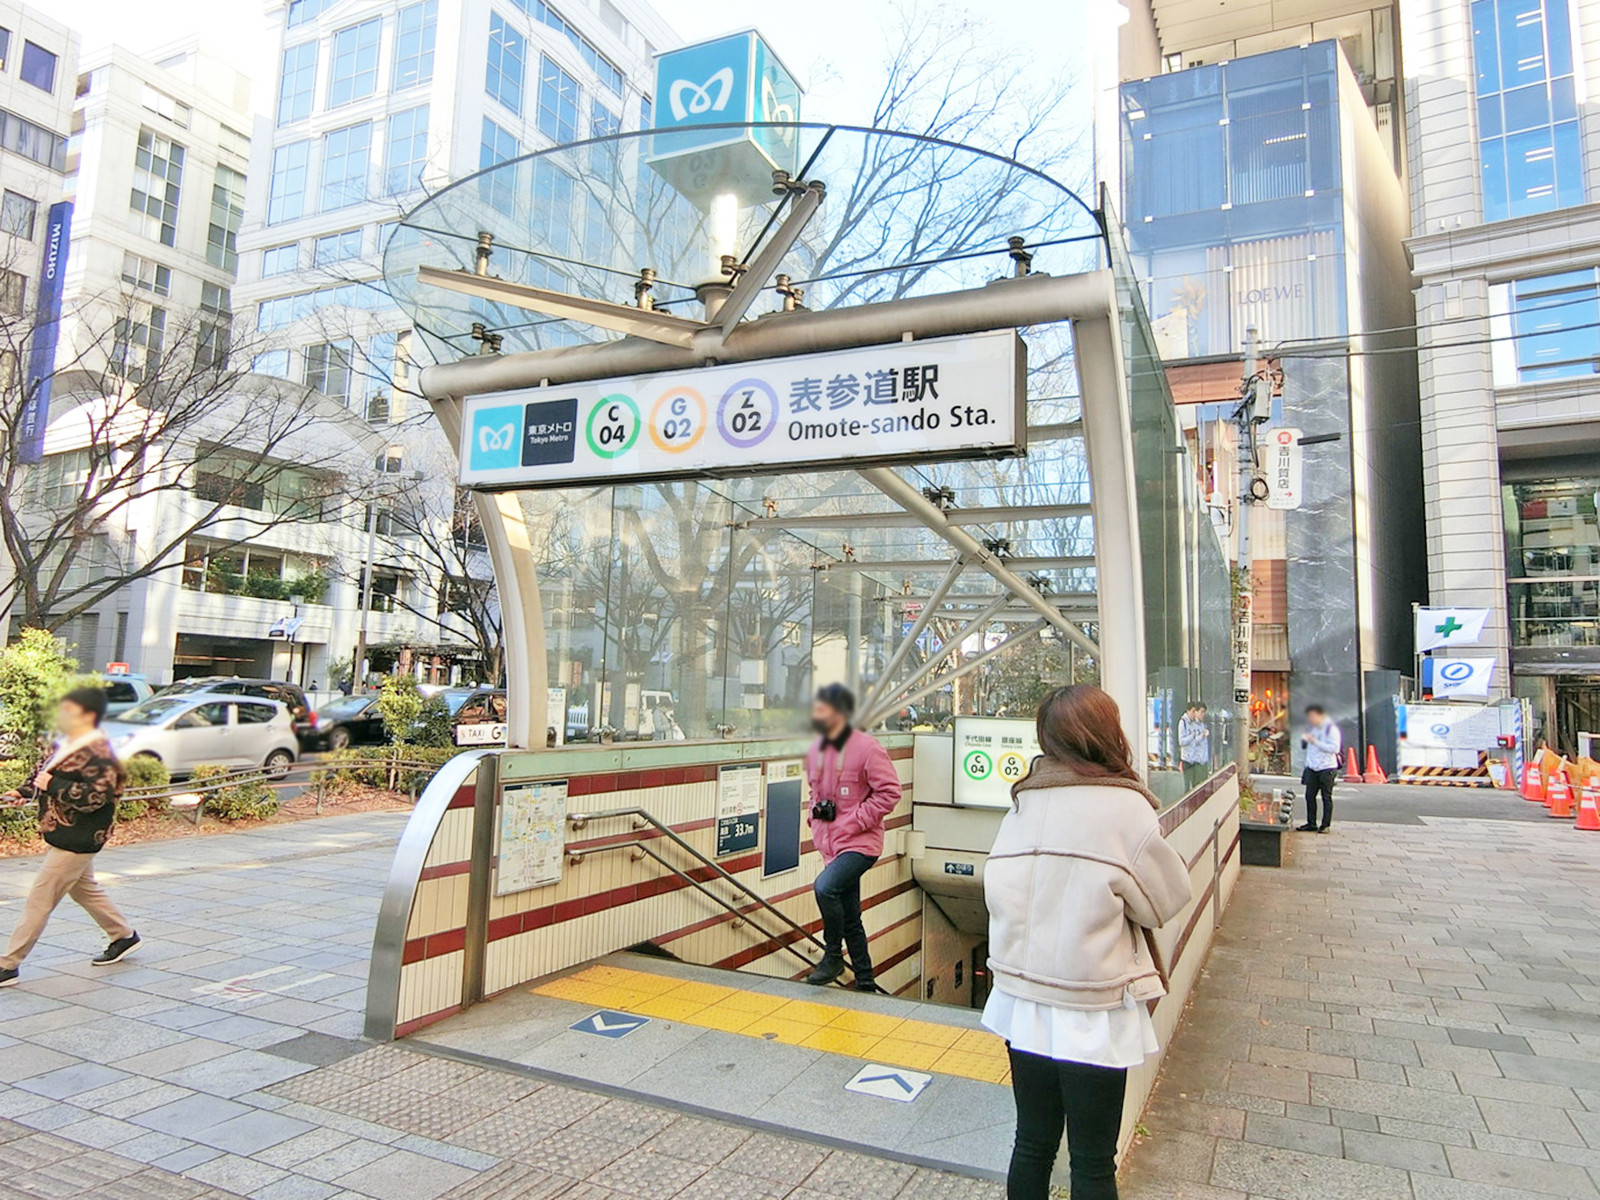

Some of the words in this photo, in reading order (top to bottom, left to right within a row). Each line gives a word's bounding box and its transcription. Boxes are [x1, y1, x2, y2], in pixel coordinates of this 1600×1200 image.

[47, 223, 62, 279] MIZUHO
[1238, 283, 1304, 305] LOEWE
[788, 364, 939, 414] 表参道駅
[671, 397, 687, 416] G
[741, 390, 755, 409] Z
[608, 404, 620, 423] C
[732, 411, 762, 433] 02
[788, 407, 940, 441] Omote-sando
[950, 405, 996, 428] Sta.
[528, 421, 572, 435] 東京メトロ
[599, 424, 626, 445] 04
[663, 418, 692, 440] 02
[530, 436, 549, 445] Tokyo
[549, 434, 569, 442] Metro
[1277, 446, 1290, 489] 吉川質店
[468, 728, 485, 738] TAXI
[971, 764, 985, 774] 04
[974, 755, 981, 764] C
[1008, 757, 1016, 766] G
[1004, 766, 1019, 776] 02
